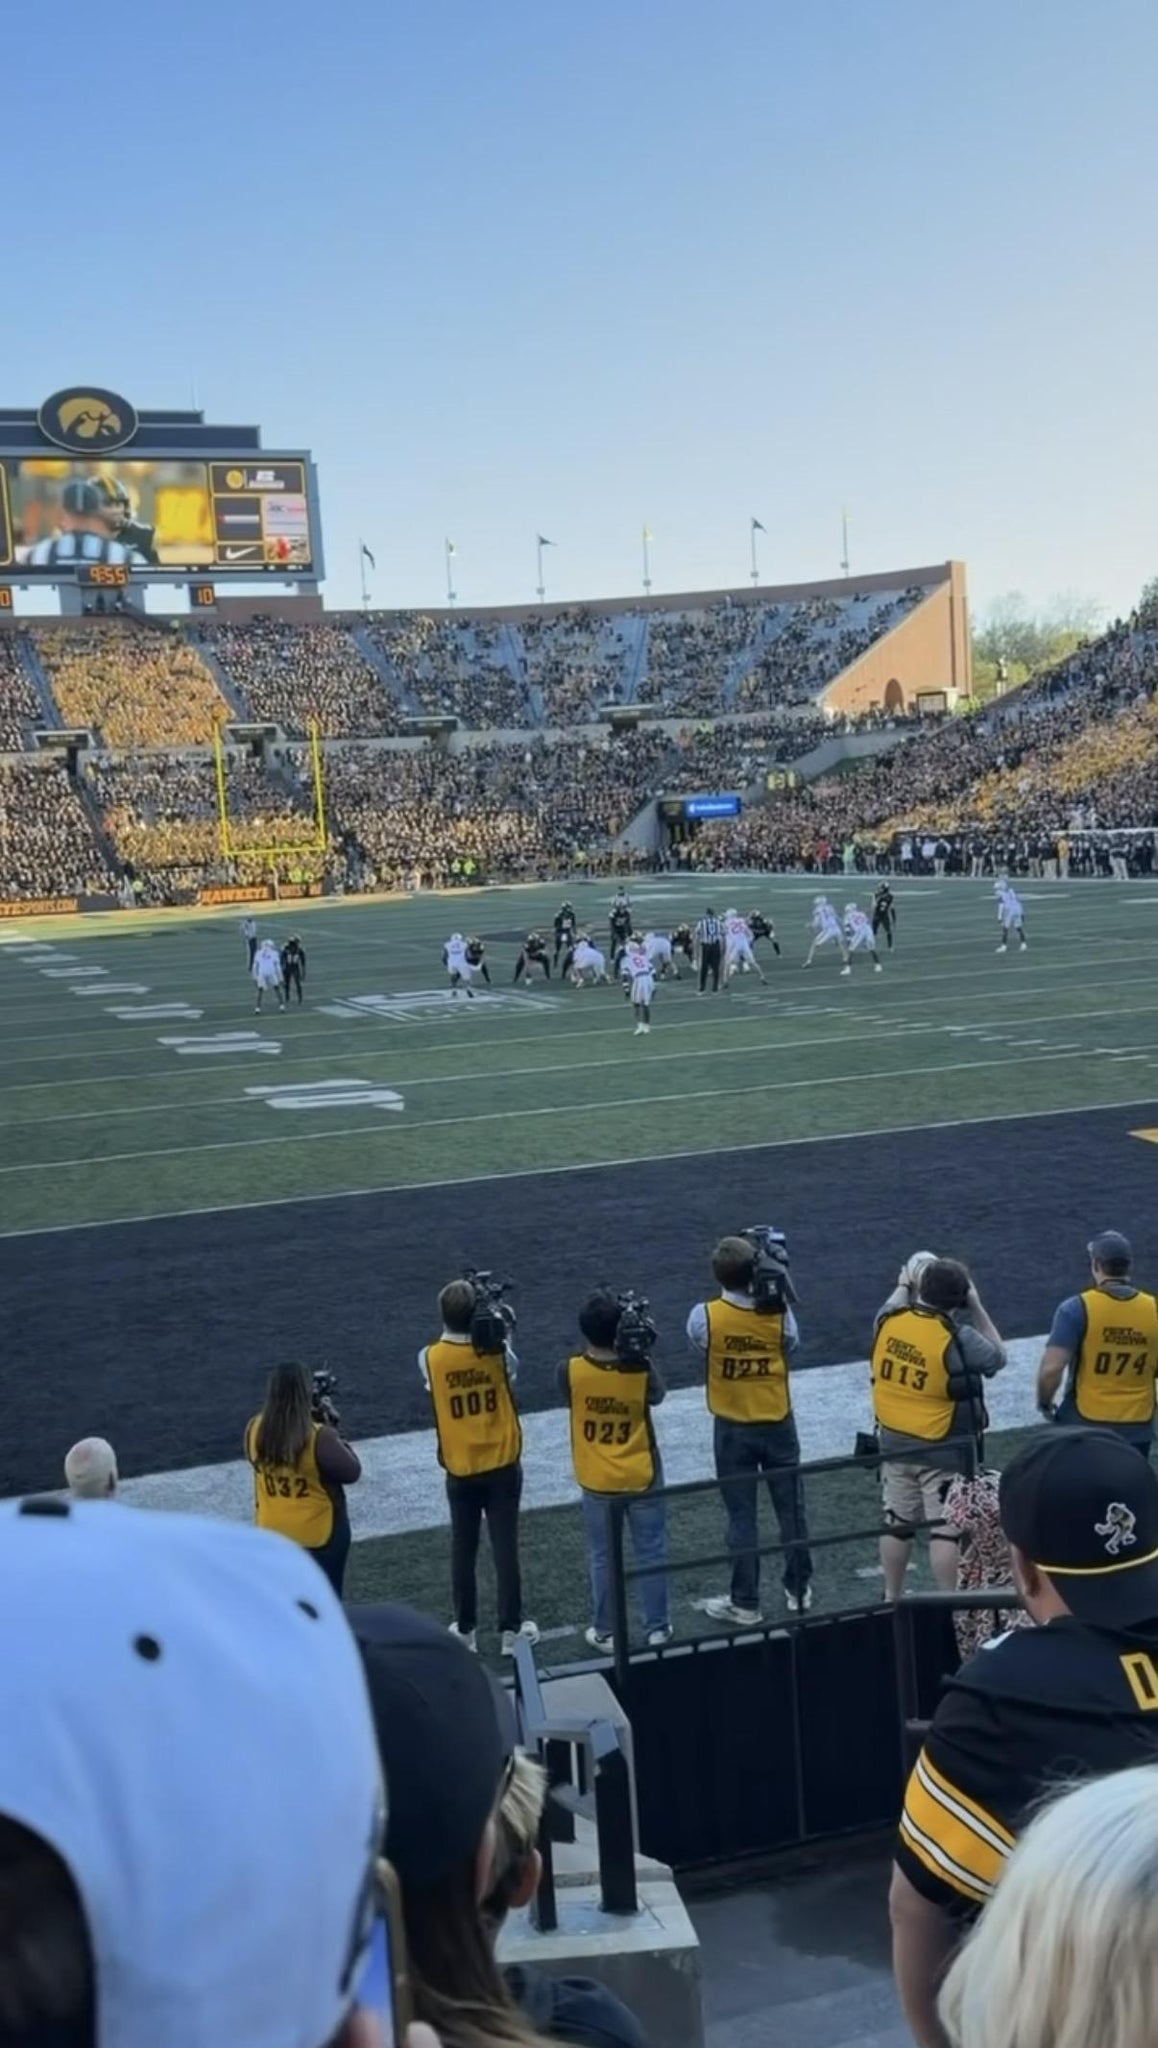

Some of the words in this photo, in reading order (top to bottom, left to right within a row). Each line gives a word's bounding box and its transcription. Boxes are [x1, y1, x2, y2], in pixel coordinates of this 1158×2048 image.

[90, 566, 126, 584] 9:55
[198, 588, 213, 605] 10
[0, 899, 78, 916] YESPORTS.COM
[722, 1357, 771, 1380] 028
[881, 1358, 929, 1391] 013
[1094, 1351, 1148, 1376] 074
[450, 1388, 497, 1420] 008
[584, 1420, 631, 1445] 023
[264, 1473, 310, 1499] 032
